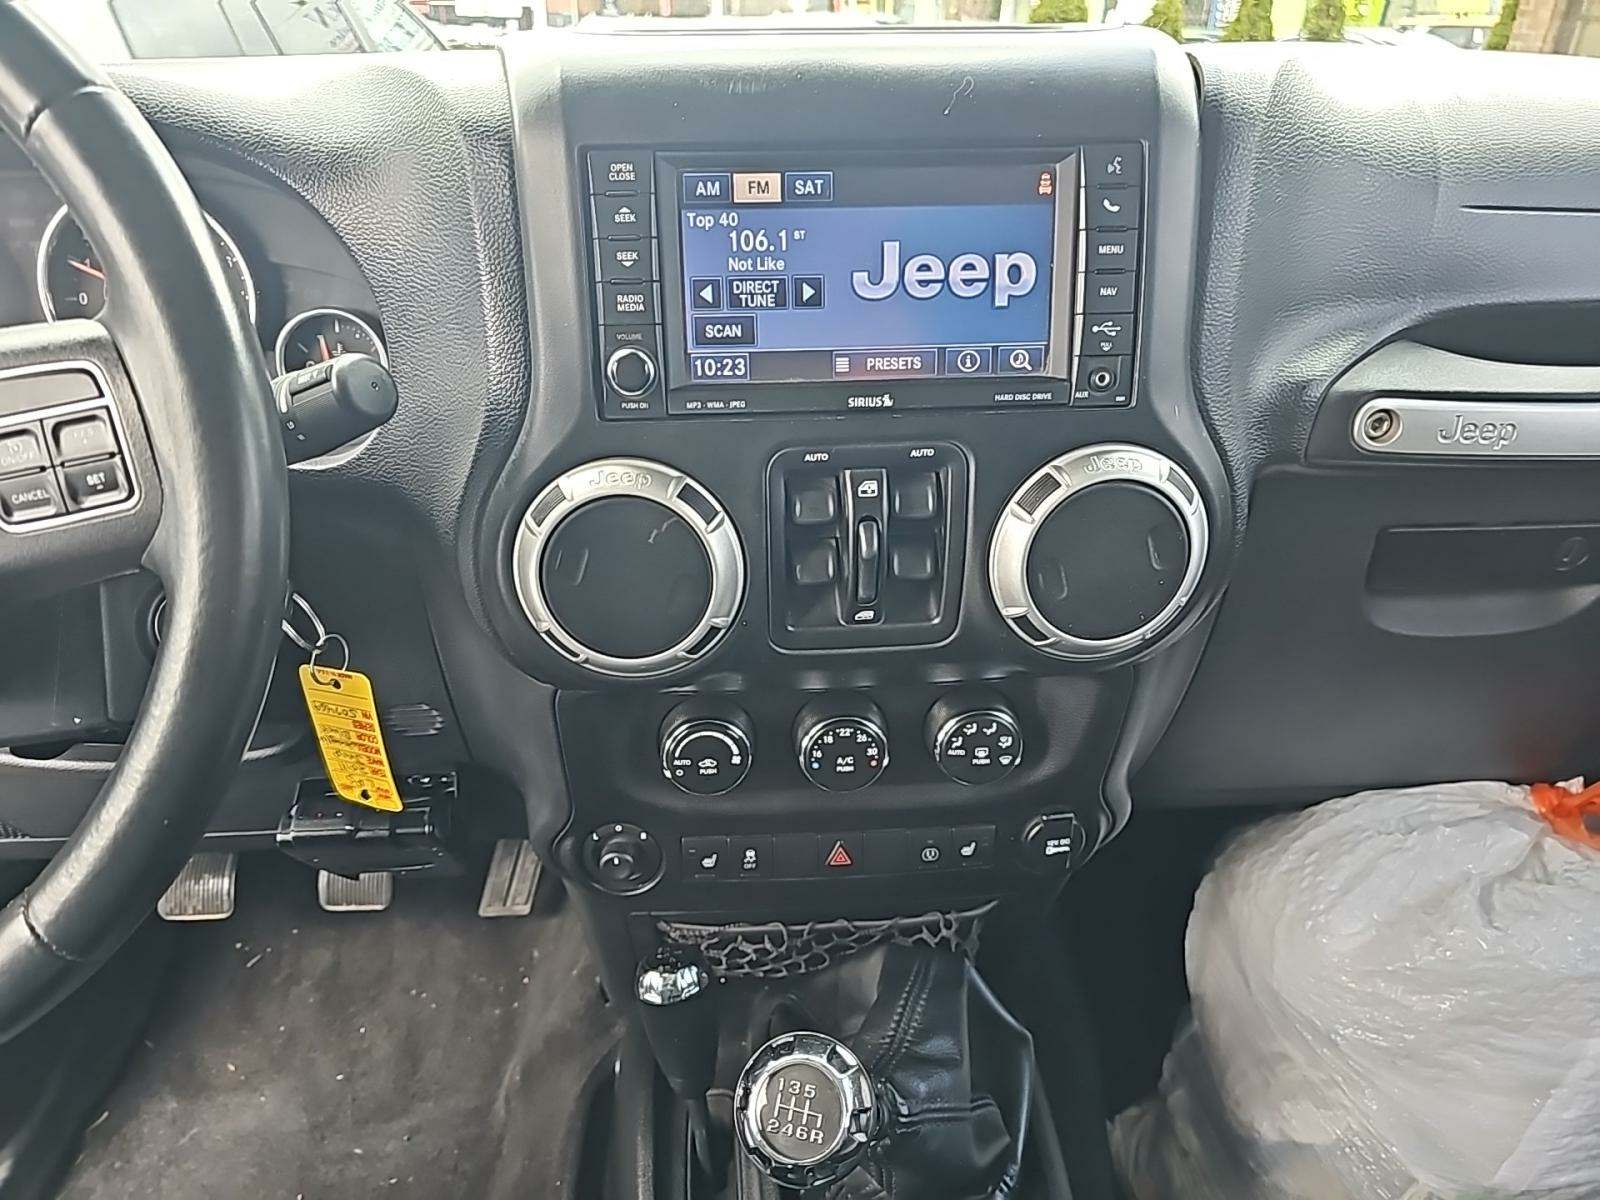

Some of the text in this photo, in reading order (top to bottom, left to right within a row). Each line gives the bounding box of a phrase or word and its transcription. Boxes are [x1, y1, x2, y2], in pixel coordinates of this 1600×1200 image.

[610, 163, 634, 172] OPEN
[609, 171, 636, 181] CLOSE
[696, 181, 720, 196] AM
[748, 181, 770, 195] FM
[794, 180, 824, 195] SAT
[614, 213, 636, 223] SEEK
[686, 212, 739, 230] Top 40
[729, 229, 806, 252] 106.1 ST
[1099, 245, 1124, 255] MENU
[616, 251, 638, 261] SEEK
[728, 257, 785, 272] Not Like
[852, 240, 1037, 307] Jeep
[732, 280, 779, 294] DIRECT
[1100, 287, 1118, 297] NAV
[617, 294, 644, 304] RADIO
[739, 294, 776, 308] TUNE
[617, 302, 645, 312] MEDIA
[705, 324, 742, 338] SCAN
[694, 358, 746, 376] 10:23
[866, 357, 922, 371] PRESETS
[1015, 393, 1032, 401] DISC
[1075, 391, 1089, 399] AUX
[729, 401, 746, 409] JPEG
[1437, 414, 1519, 450] Jeep
[804, 453, 829, 462] AUTO
[910, 448, 935, 457] AUTO
[86, 472, 106, 487] SET
[589, 470, 652, 489] Jeep
[11, 488, 50, 504] CANCEL
[839, 728, 851, 737] 22
[823, 735, 834, 744] 18
[856, 734, 867, 743] 26
[812, 750, 823, 758] 16
[836, 756, 854, 765] A/C
